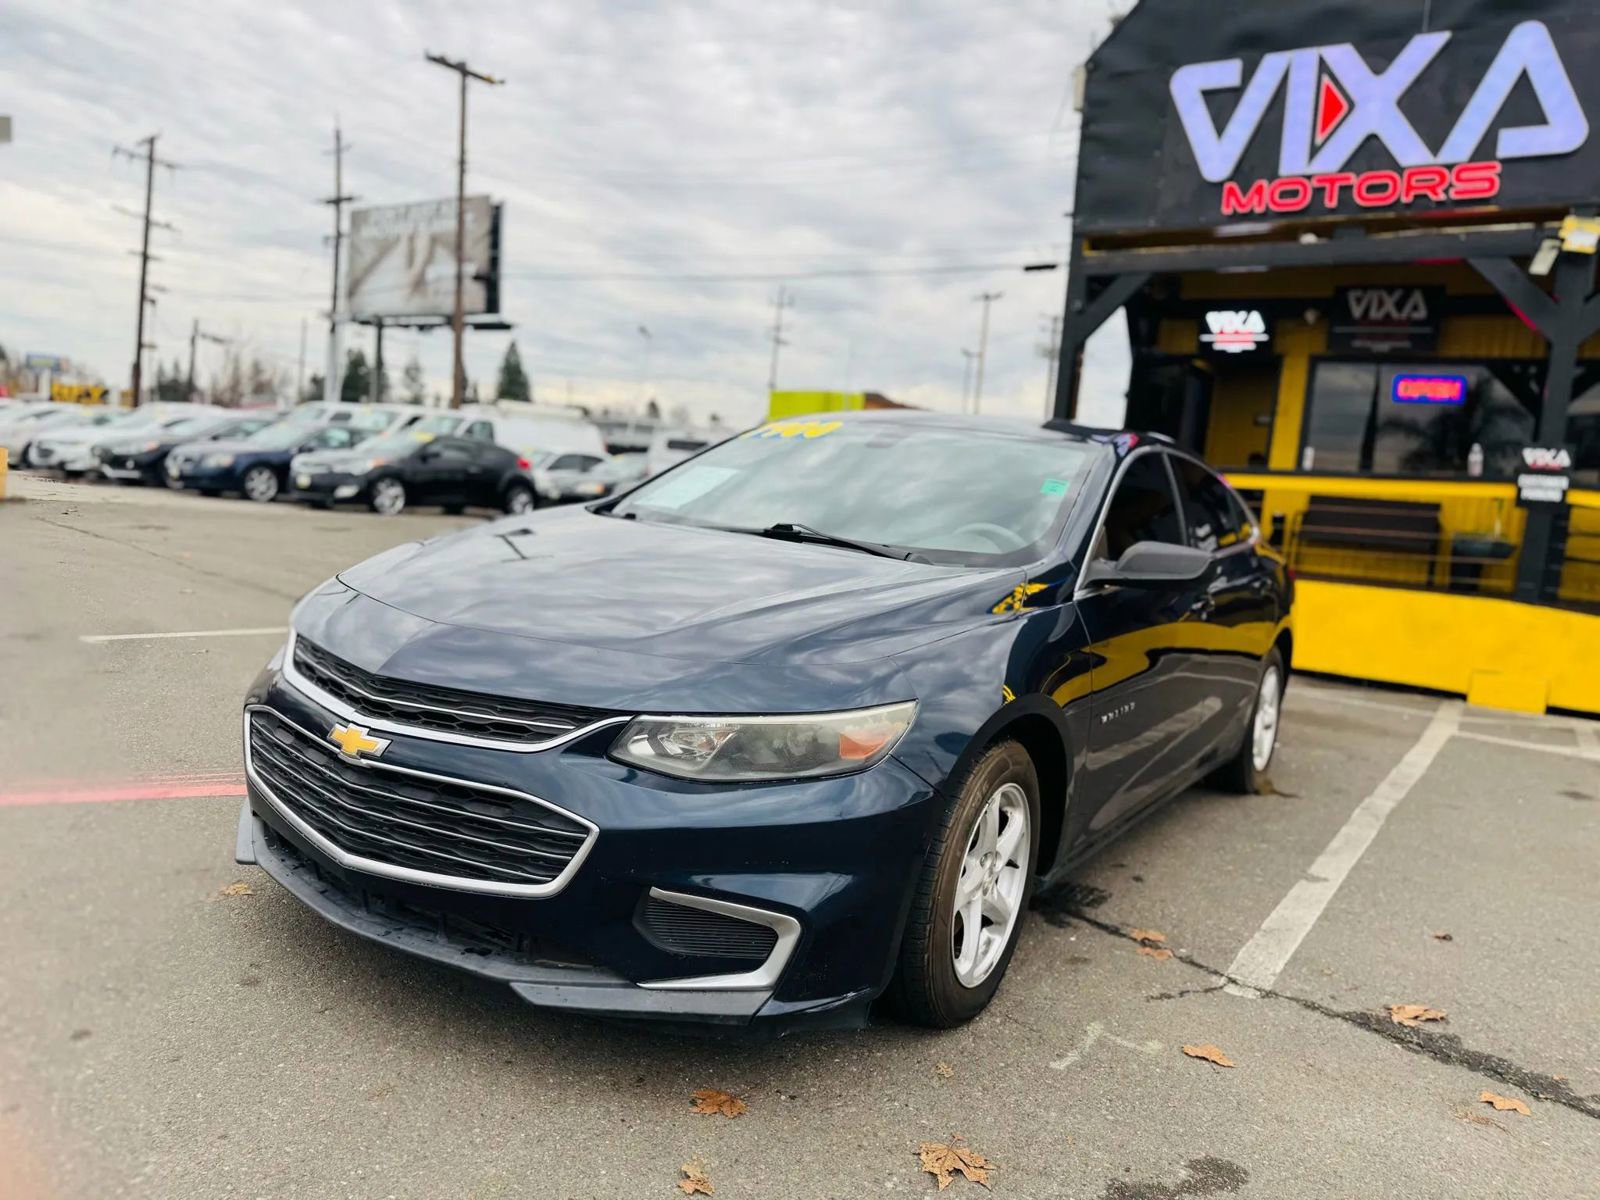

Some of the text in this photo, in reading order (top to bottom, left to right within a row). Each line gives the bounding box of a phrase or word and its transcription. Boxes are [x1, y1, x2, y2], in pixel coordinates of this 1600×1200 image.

[1170, 20, 1589, 182] VIXA
[1221, 161, 1502, 214] MOTORS
[1347, 287, 1428, 320] VIXA
